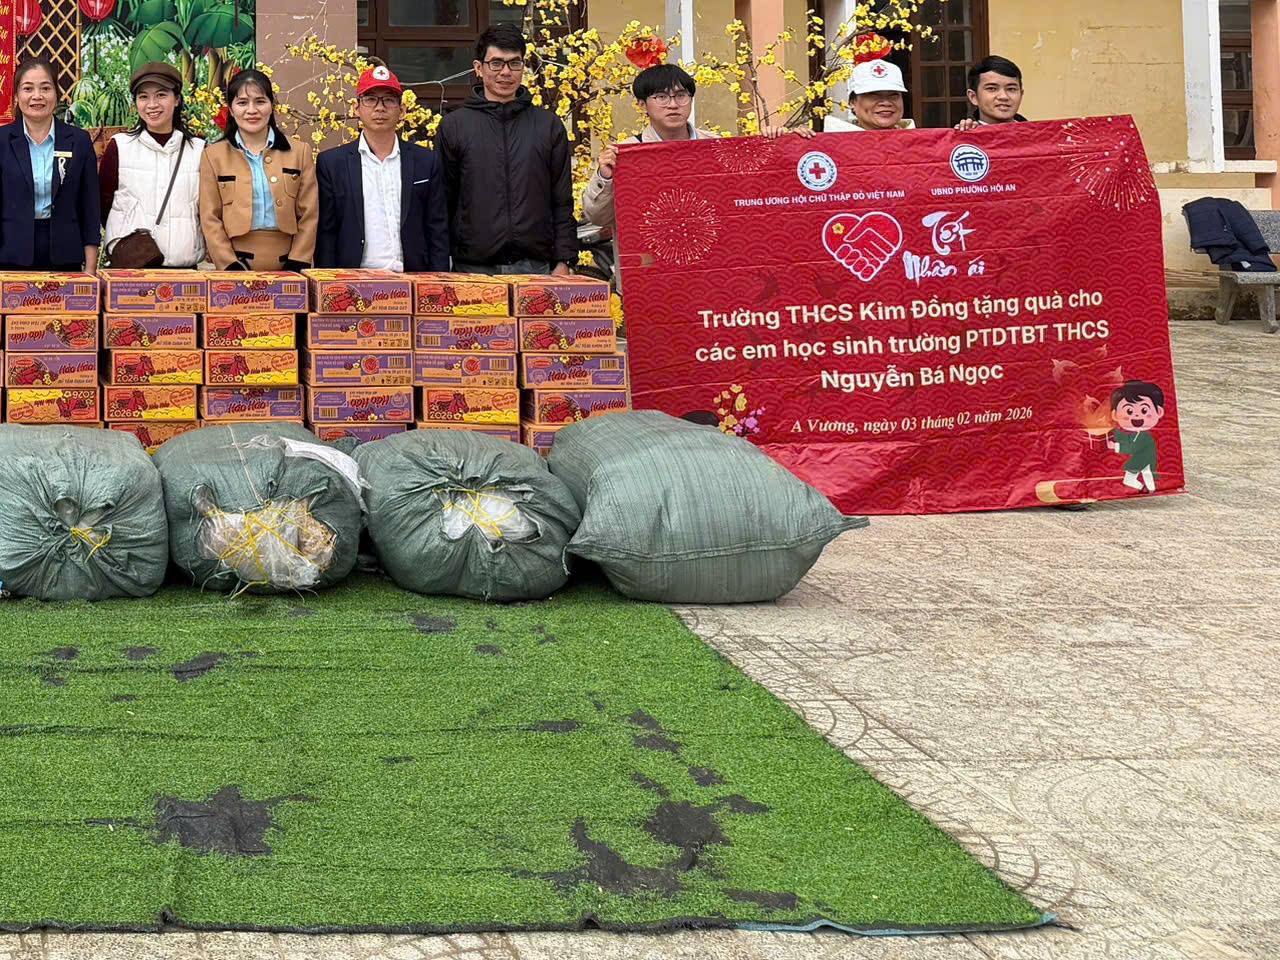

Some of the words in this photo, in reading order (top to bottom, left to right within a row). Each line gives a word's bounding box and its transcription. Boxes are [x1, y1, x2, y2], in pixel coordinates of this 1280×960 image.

[734, 198, 764, 207] TRUNG
[791, 194, 807, 205] HỘI
[829, 191, 851, 203] THẬP
[867, 190, 885, 201] VIỆT
[886, 190, 905, 199] NAM
[931, 188, 953, 196] UBND
[954, 185, 988, 195] PHƯỜNG
[990, 184, 1004, 193] HỘI
[1005, 184, 1016, 192] AN
[922, 211, 976, 255] Tết
[903, 250, 958, 286] Nhân
[967, 254, 985, 277] ái
[698, 307, 780, 330] Trường
[785, 302, 853, 324] THCS
[859, 301, 905, 321] Kim
[910, 295, 968, 321] Đồng
[973, 295, 1019, 319] tặng
[1024, 291, 1063, 315] quà
[1068, 289, 1103, 308] cho
[695, 343, 736, 362] các
[742, 343, 777, 359] em
[783, 340, 826, 361] học
[832, 336, 883, 355] sinh
[888, 333, 960, 354] trường
[966, 325, 1048, 349] PTDTBT
[1053, 320, 1109, 342] THCS
[821, 364, 914, 393] Nguyễn
[920, 366, 945, 386] Bá
[949, 364, 1003, 384] Ngọc
[791, 420, 803, 433] A
[808, 419, 858, 434] Vương,
[863, 418, 897, 434] ngày
[901, 417, 917, 431] 03
[921, 415, 955, 430] tháng
[957, 412, 970, 425] 02
[974, 410, 1002, 423] năm
[1004, 406, 1033, 421] 2026
